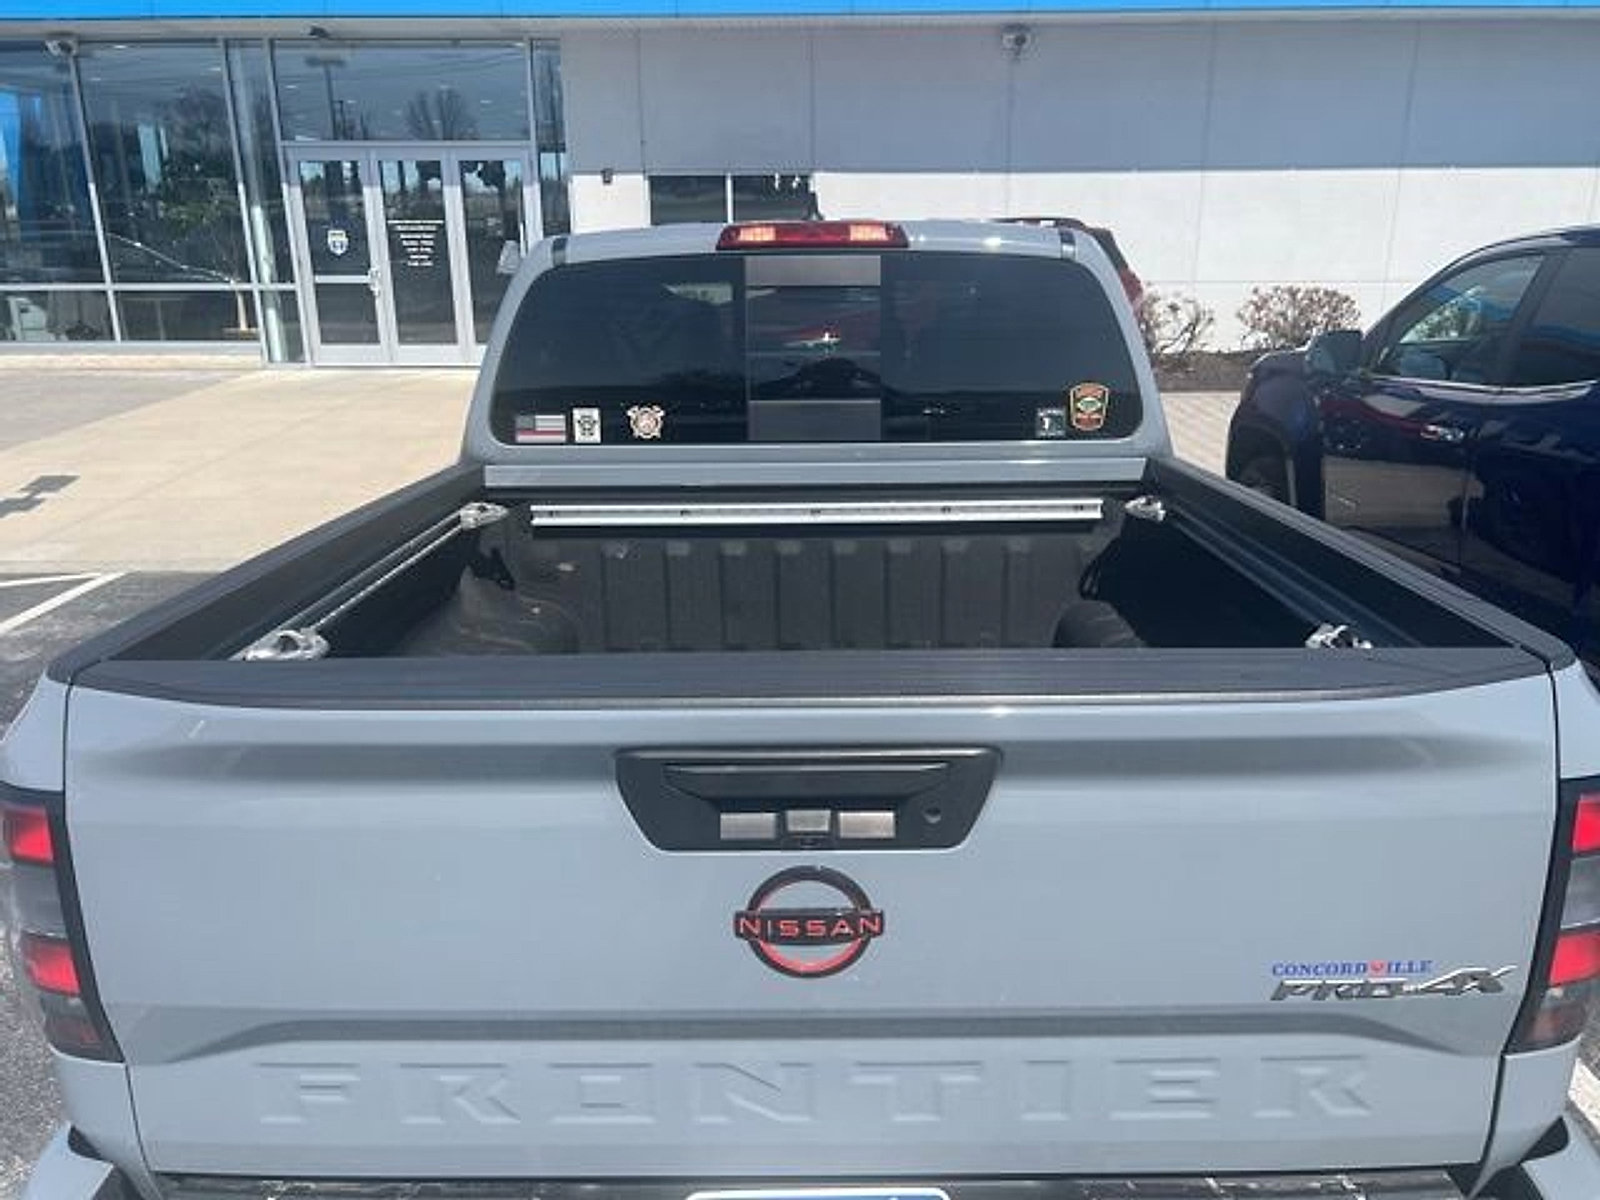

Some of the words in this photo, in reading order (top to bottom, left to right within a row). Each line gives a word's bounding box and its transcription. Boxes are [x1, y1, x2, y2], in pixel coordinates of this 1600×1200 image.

[738, 914, 882, 938] NISSAN
[1272, 960, 1433, 977] CONCORDVILLE
[254, 1056, 1372, 1127] FRONTIER
